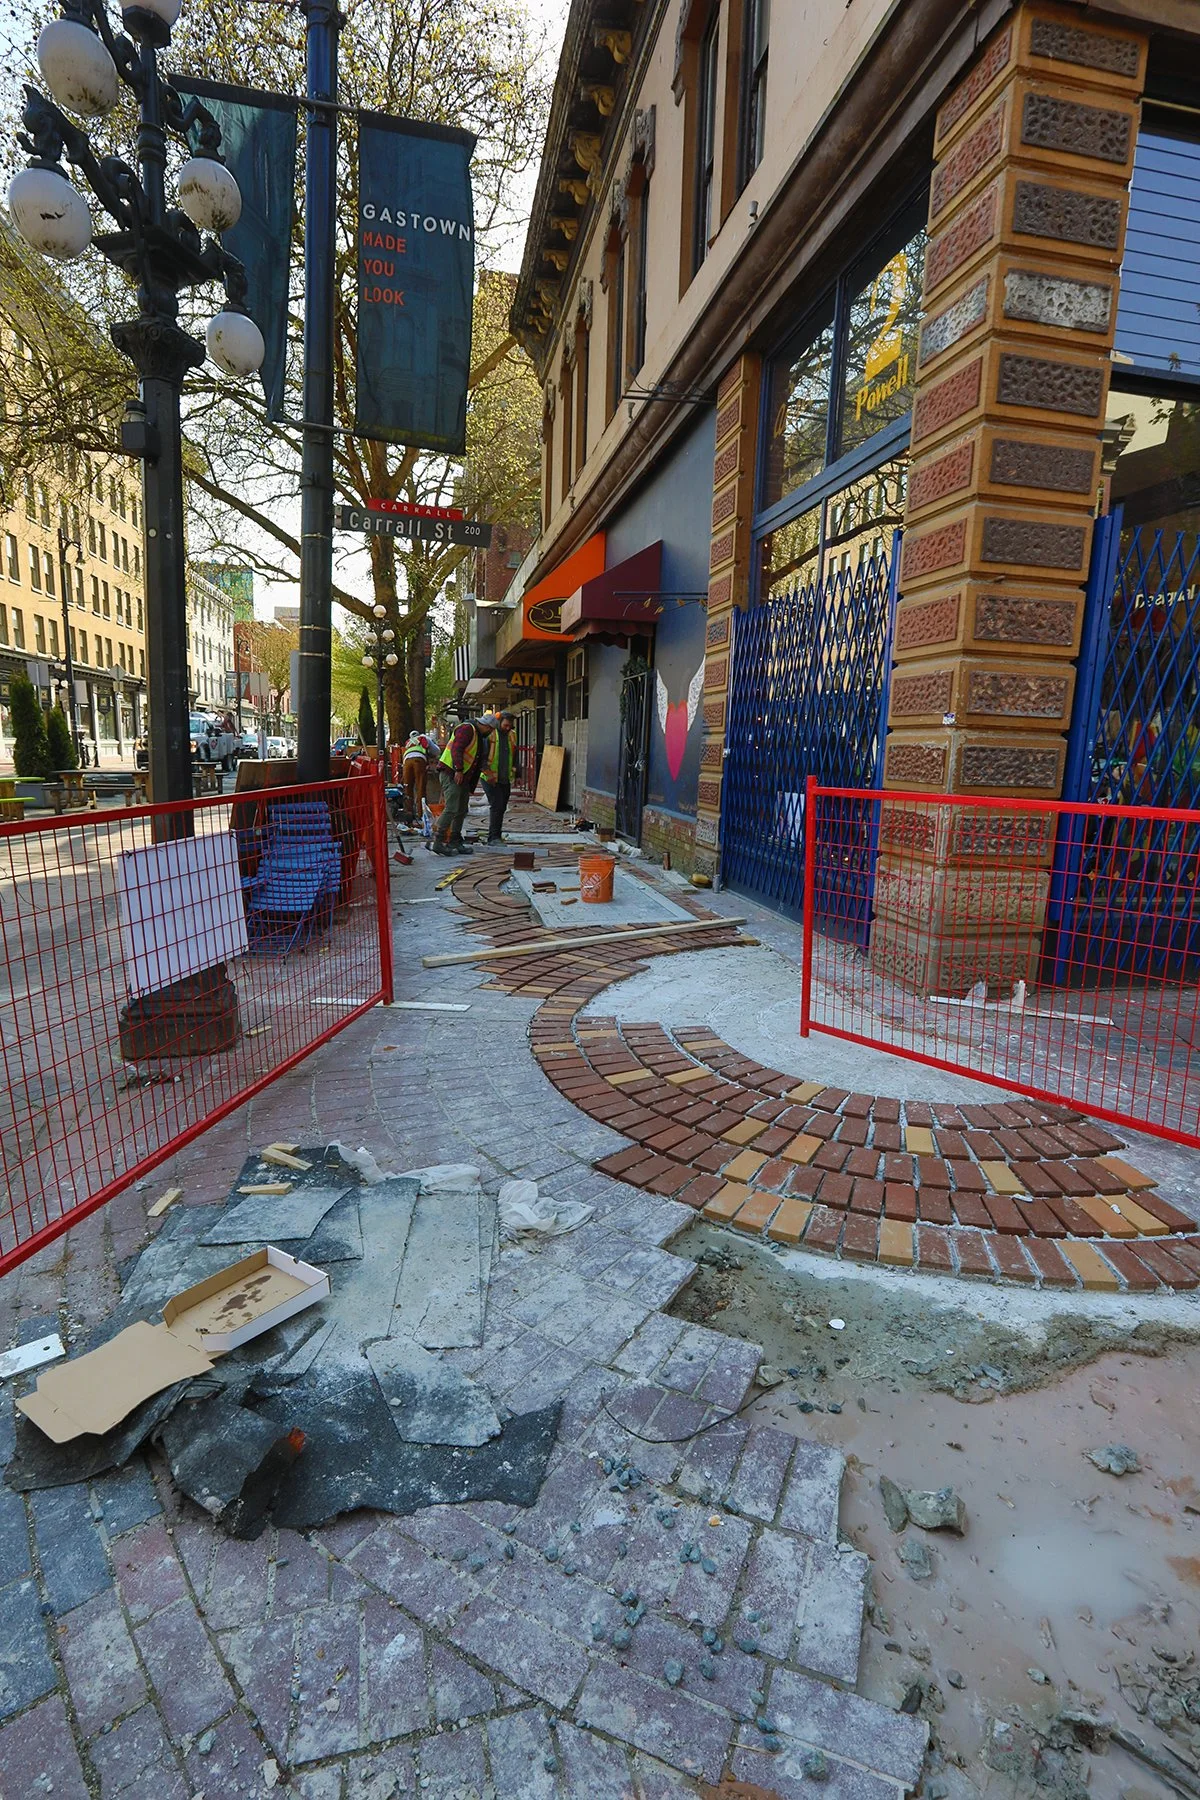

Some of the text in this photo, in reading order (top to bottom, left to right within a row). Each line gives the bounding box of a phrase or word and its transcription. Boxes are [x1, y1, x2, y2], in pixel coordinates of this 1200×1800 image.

[362, 203, 471, 241] GASTOWN
[363, 231, 406, 254] MADE
[363, 259, 395, 277] YOU
[363, 287, 405, 306] LOOK
[855, 353, 909, 422] Powell
[380, 502, 451, 518] CARRALL
[349, 511, 481, 540] Carrall St 200
[510, 671, 549, 688] ATM
